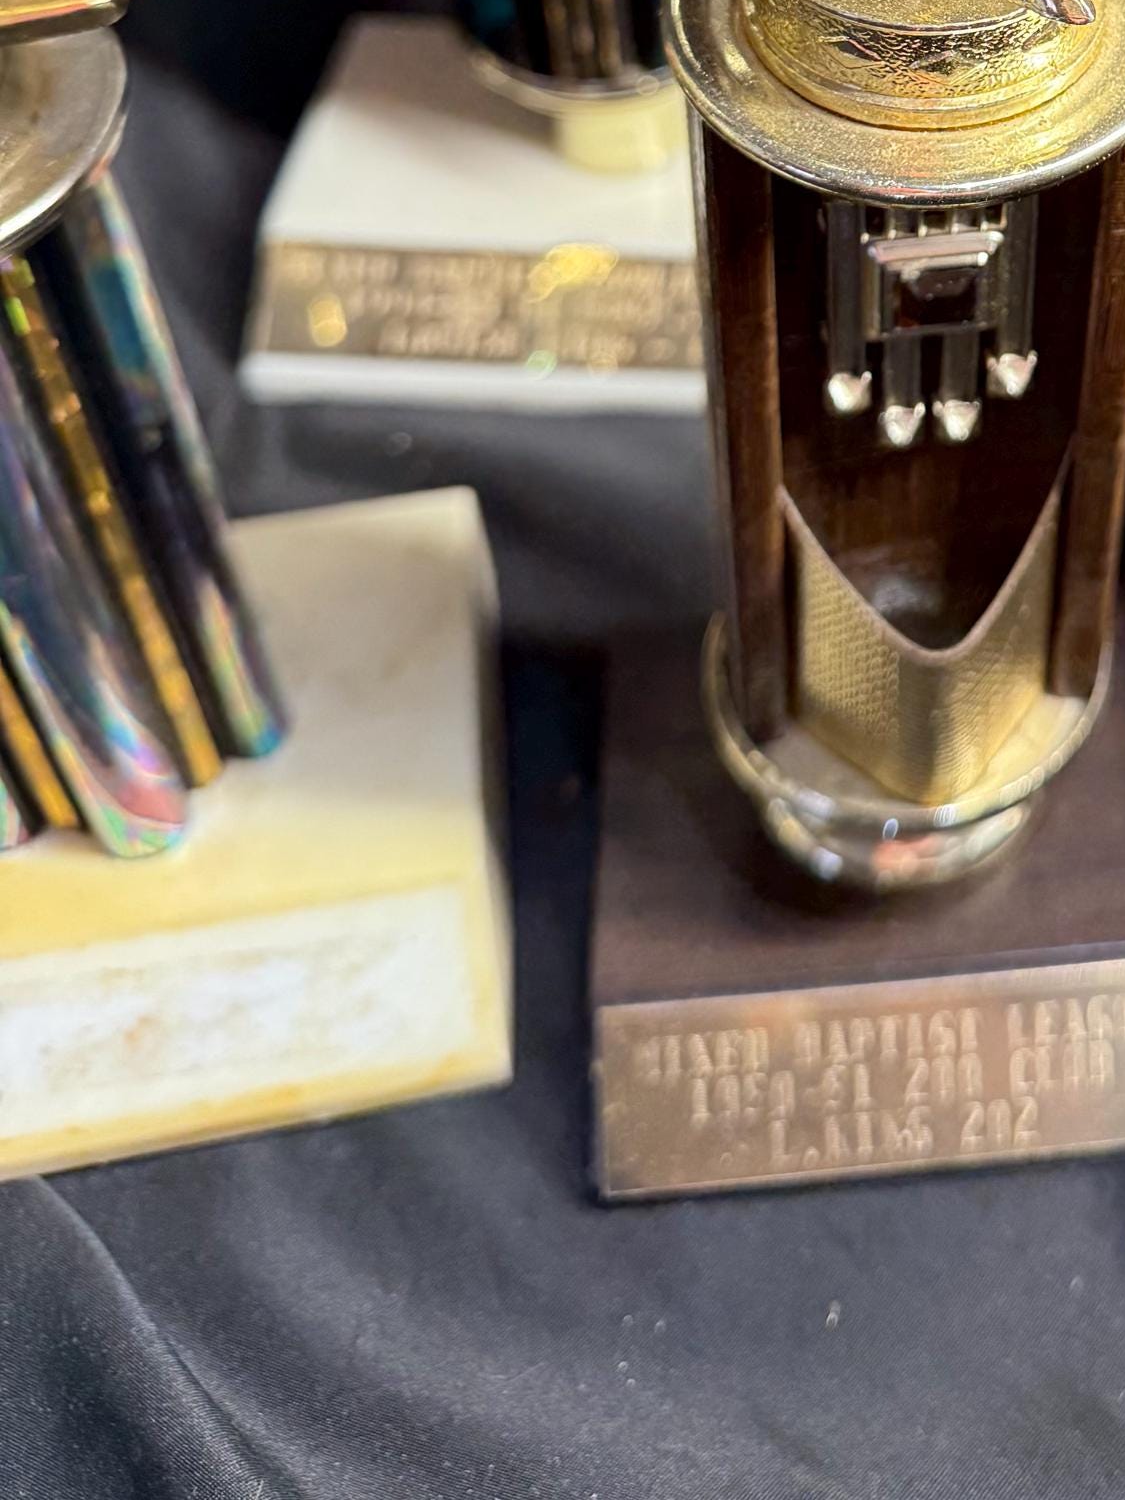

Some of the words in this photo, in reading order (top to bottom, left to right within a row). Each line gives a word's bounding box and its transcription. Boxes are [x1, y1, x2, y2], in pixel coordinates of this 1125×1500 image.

[795, 1007, 980, 1070] BAPTIST
[903, 1051, 984, 1106] 200
[960, 1097, 1041, 1153] 202
